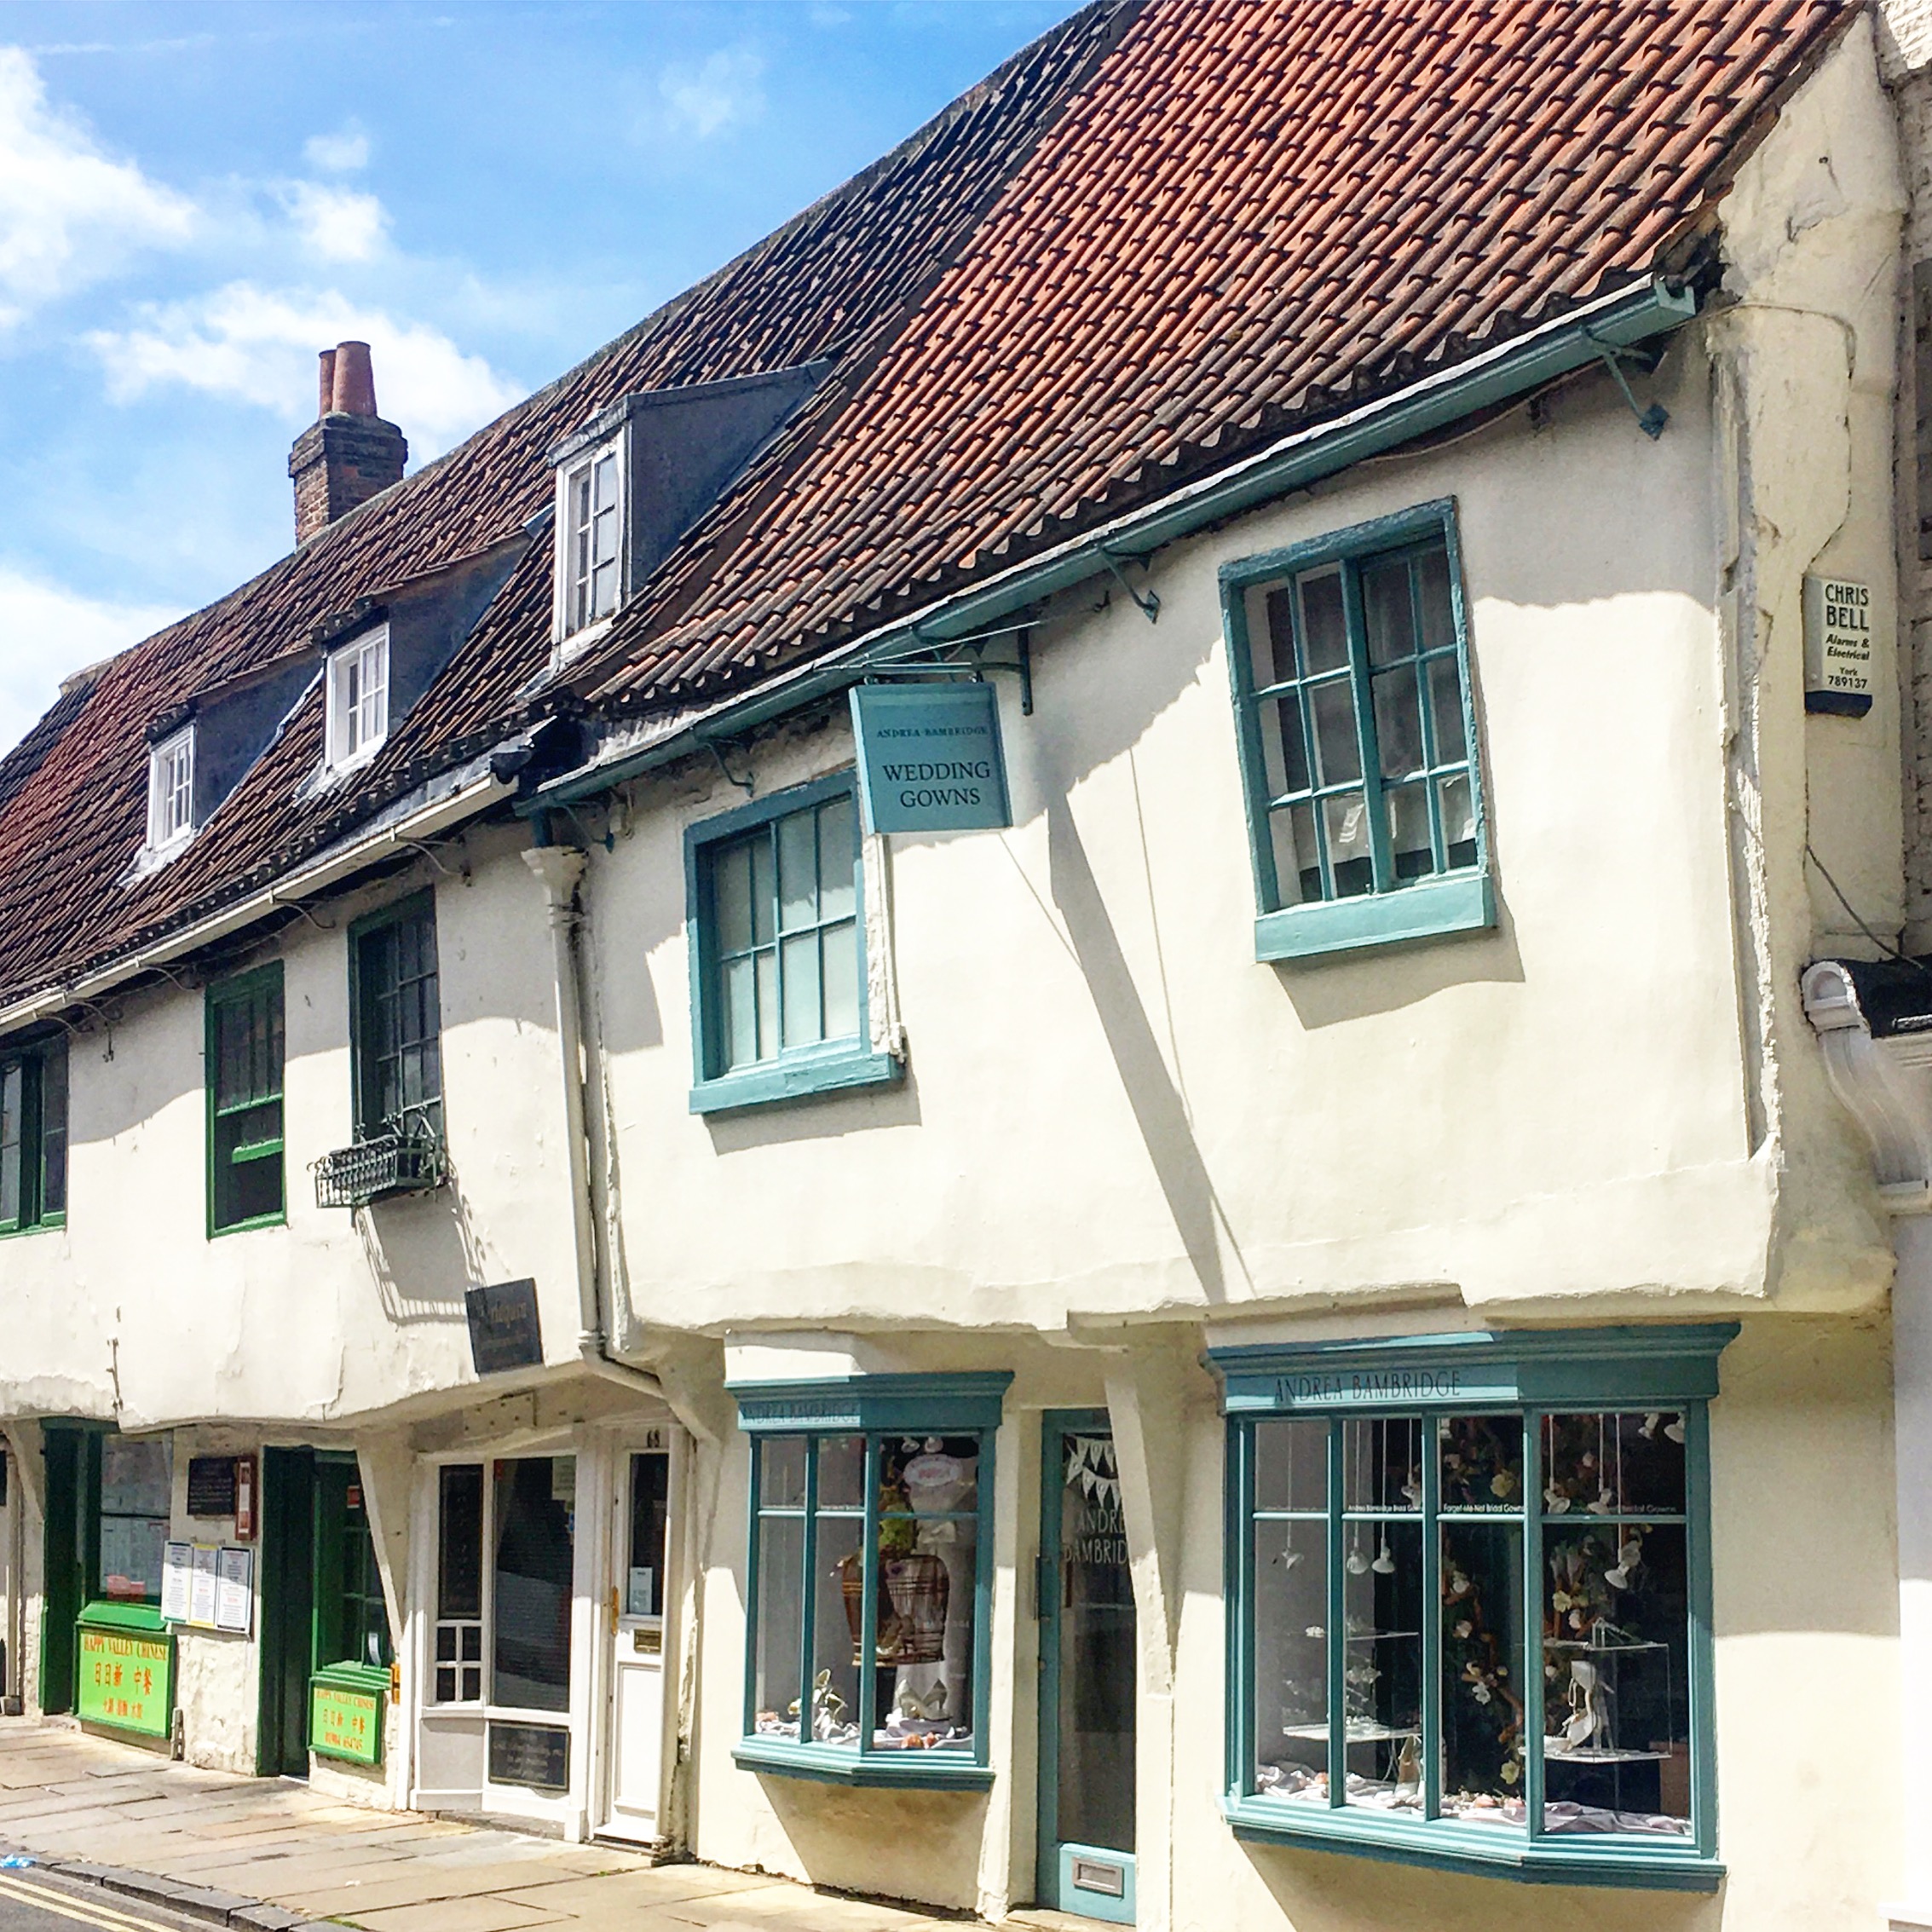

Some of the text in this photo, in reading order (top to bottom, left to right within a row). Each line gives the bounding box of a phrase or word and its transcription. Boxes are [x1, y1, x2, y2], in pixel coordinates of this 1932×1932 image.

[1825, 584, 1869, 606] CHRIS
[1826, 605, 1869, 631] BELL
[1825, 633, 1870, 649] Alarms &
[1827, 646, 1870, 660] Electrical
[1827, 674, 1868, 689] 789137
[1839, 666, 1858, 677] York
[877, 729, 920, 739] ANDREA
[883, 761, 990, 781] WEDDING
[900, 787, 981, 808] GOWNS
[1274, 1370, 1461, 1403] ANDREA BAMBRIDGE
[84, 1635, 104, 1654] HAPPY
[107, 1636, 133, 1657] VALLEY
